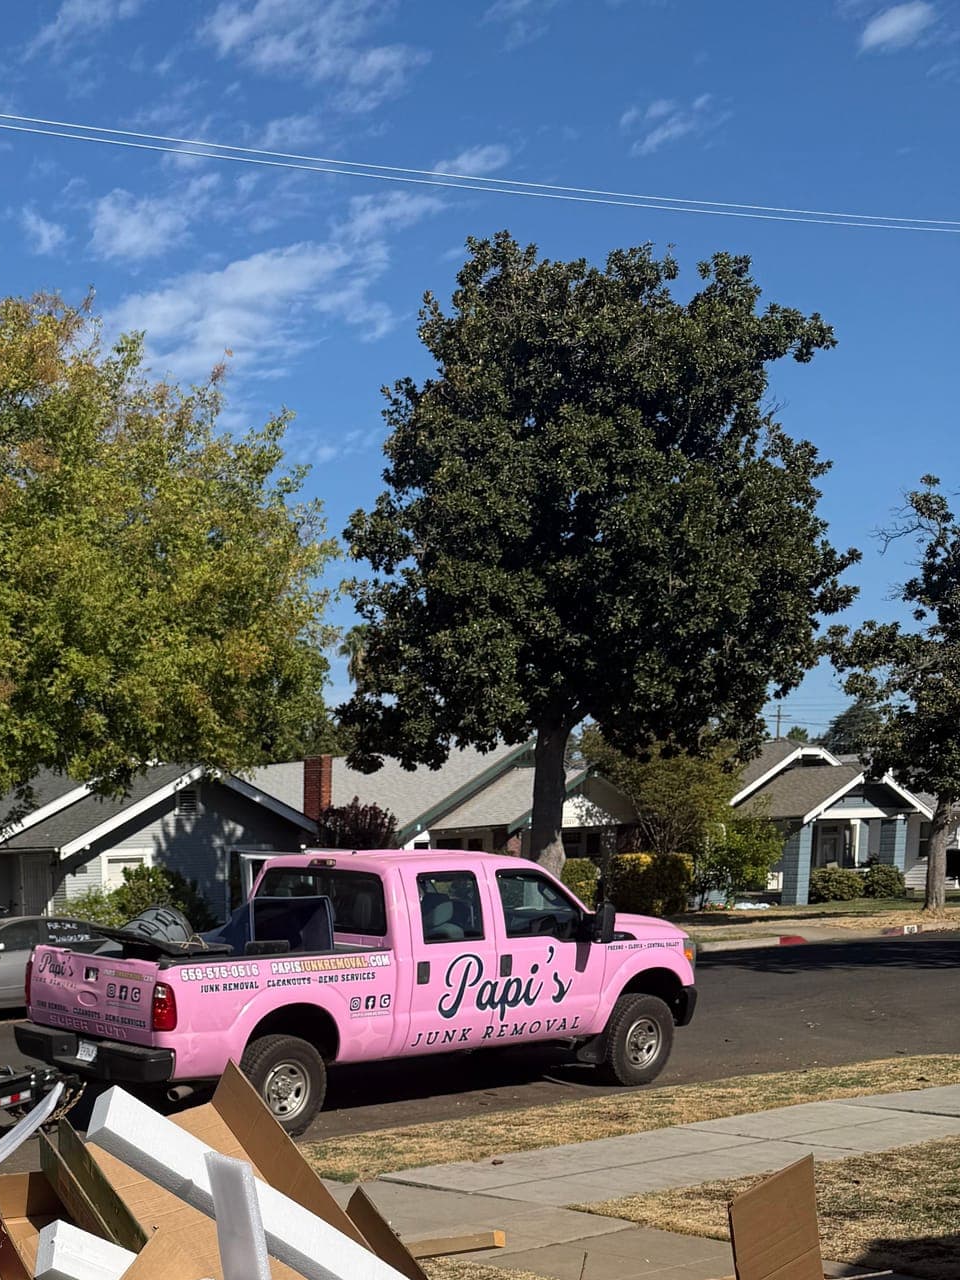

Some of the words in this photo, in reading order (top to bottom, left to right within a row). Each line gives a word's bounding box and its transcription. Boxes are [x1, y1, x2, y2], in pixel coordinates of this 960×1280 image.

[39, 952, 74, 978] Papi's
[180, 965, 259, 981] 559-575-0516
[272, 955, 390, 974] PAPISJUNKREMOVAL.COM
[201, 984, 220, 993] JUNK
[222, 982, 259, 992] REMOVAL
[267, 977, 311, 988] CLEANOUTS
[318, 974, 339, 984] DEMO
[341, 972, 376, 982] SERVICES
[438, 946, 572, 1022] Papi's
[49, 1013, 88, 1030] SUPER
[96, 1022, 128, 1038] DUTY
[412, 1027, 472, 1047] JUNK
[482, 1016, 580, 1040] REMOVAL
